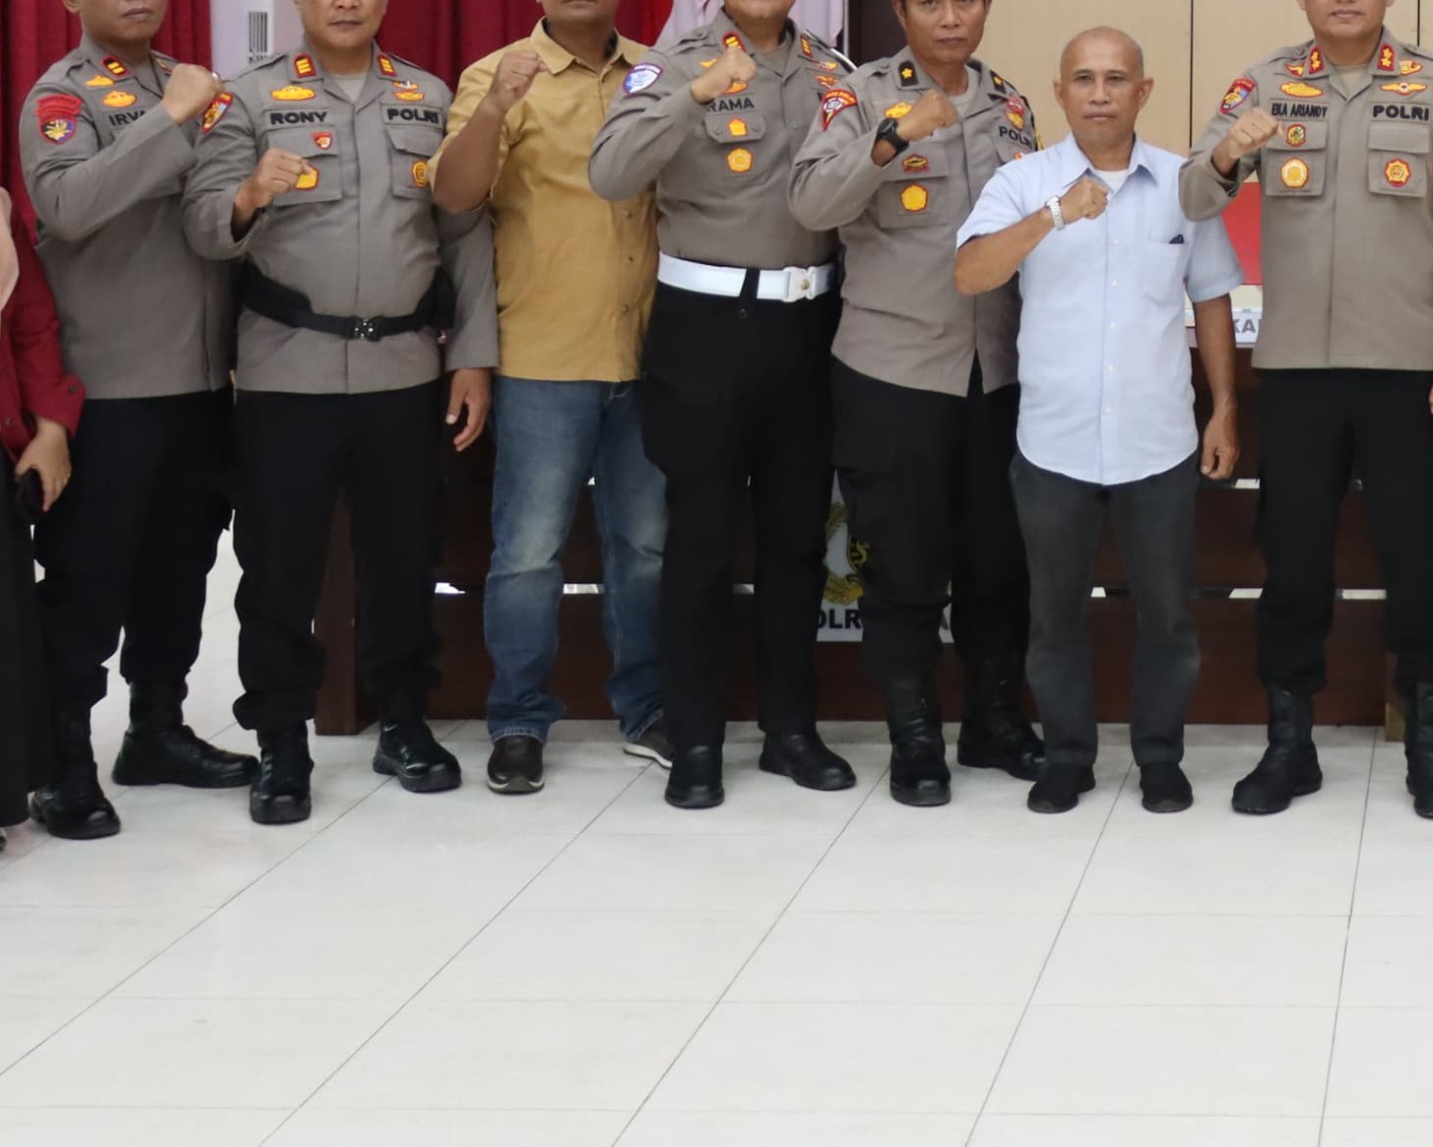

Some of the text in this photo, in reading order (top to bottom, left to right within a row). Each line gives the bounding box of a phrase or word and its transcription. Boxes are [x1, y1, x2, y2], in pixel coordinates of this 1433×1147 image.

[269, 110, 329, 126] RONY
[387, 107, 441, 125] POLRI
[1372, 104, 1430, 122] POLRI
